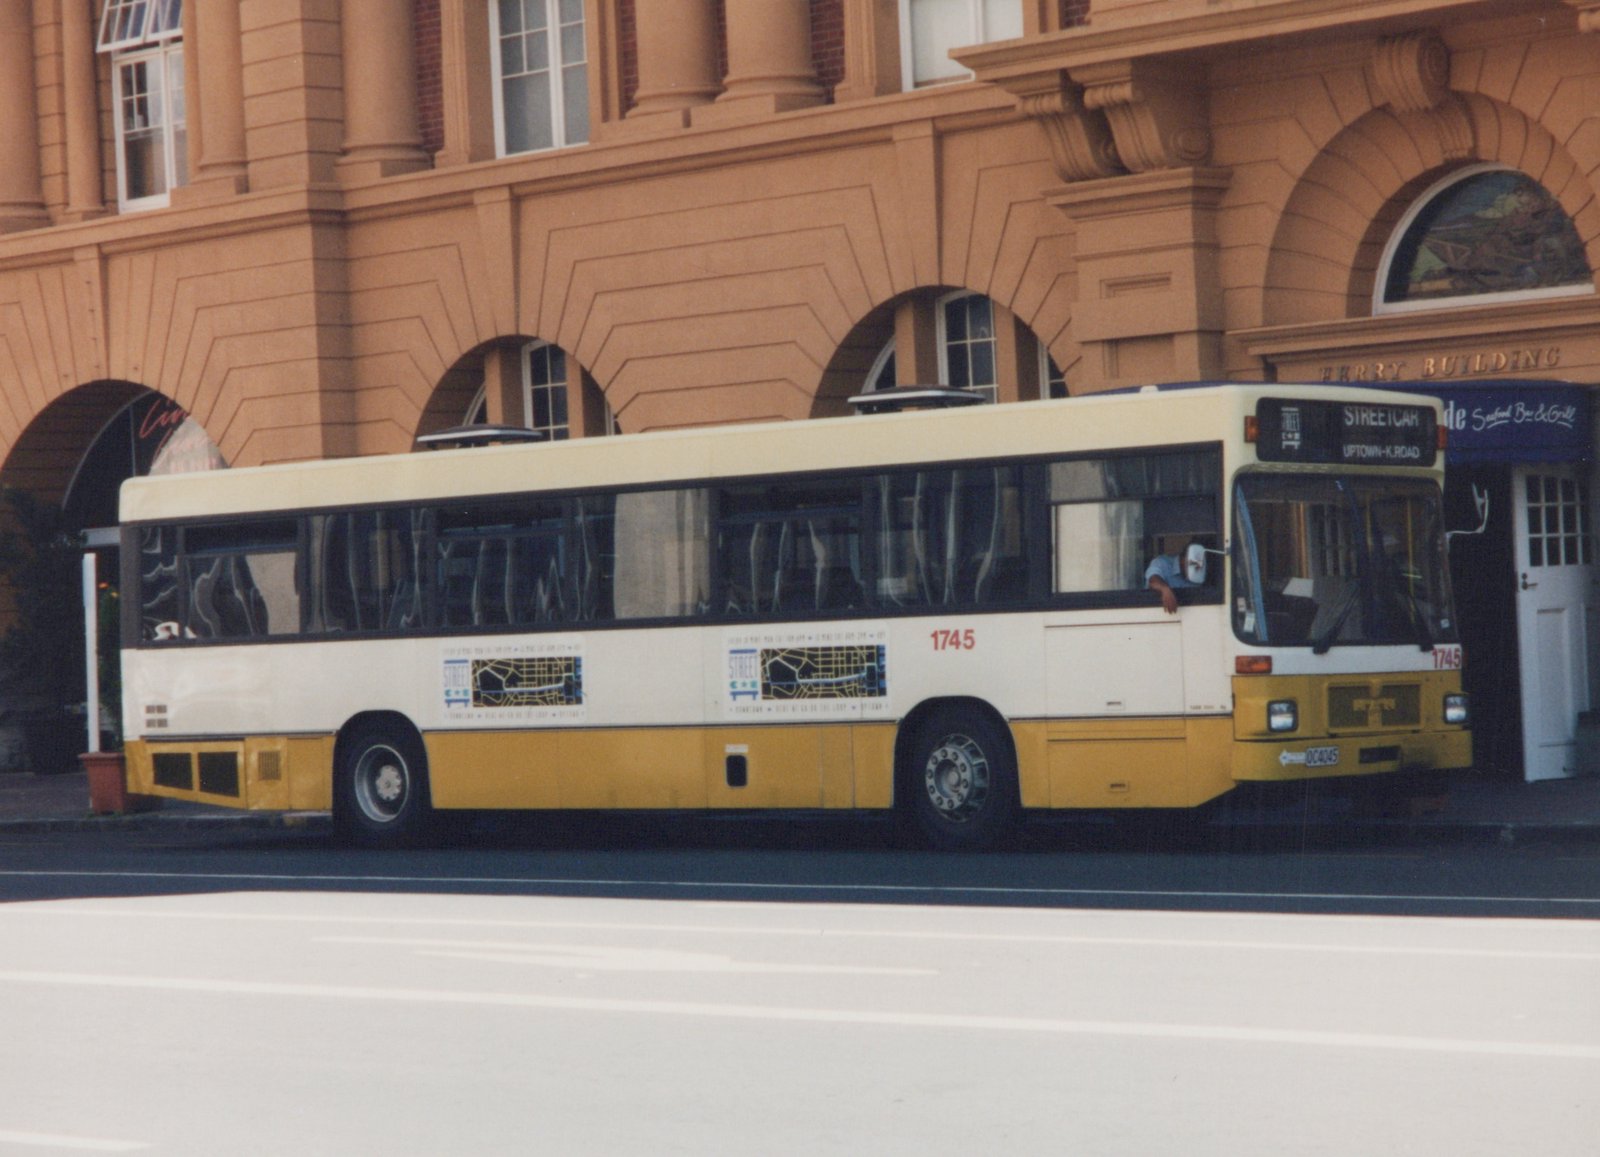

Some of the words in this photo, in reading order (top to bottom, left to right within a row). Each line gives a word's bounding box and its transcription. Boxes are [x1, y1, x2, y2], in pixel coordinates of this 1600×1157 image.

[1319, 361, 1406, 382] FERRY
[1421, 346, 1561, 378] BUILDING
[1344, 405, 1419, 427] STREETCAR
[930, 629, 975, 651] 1745
[1432, 647, 1461, 669] 1745
